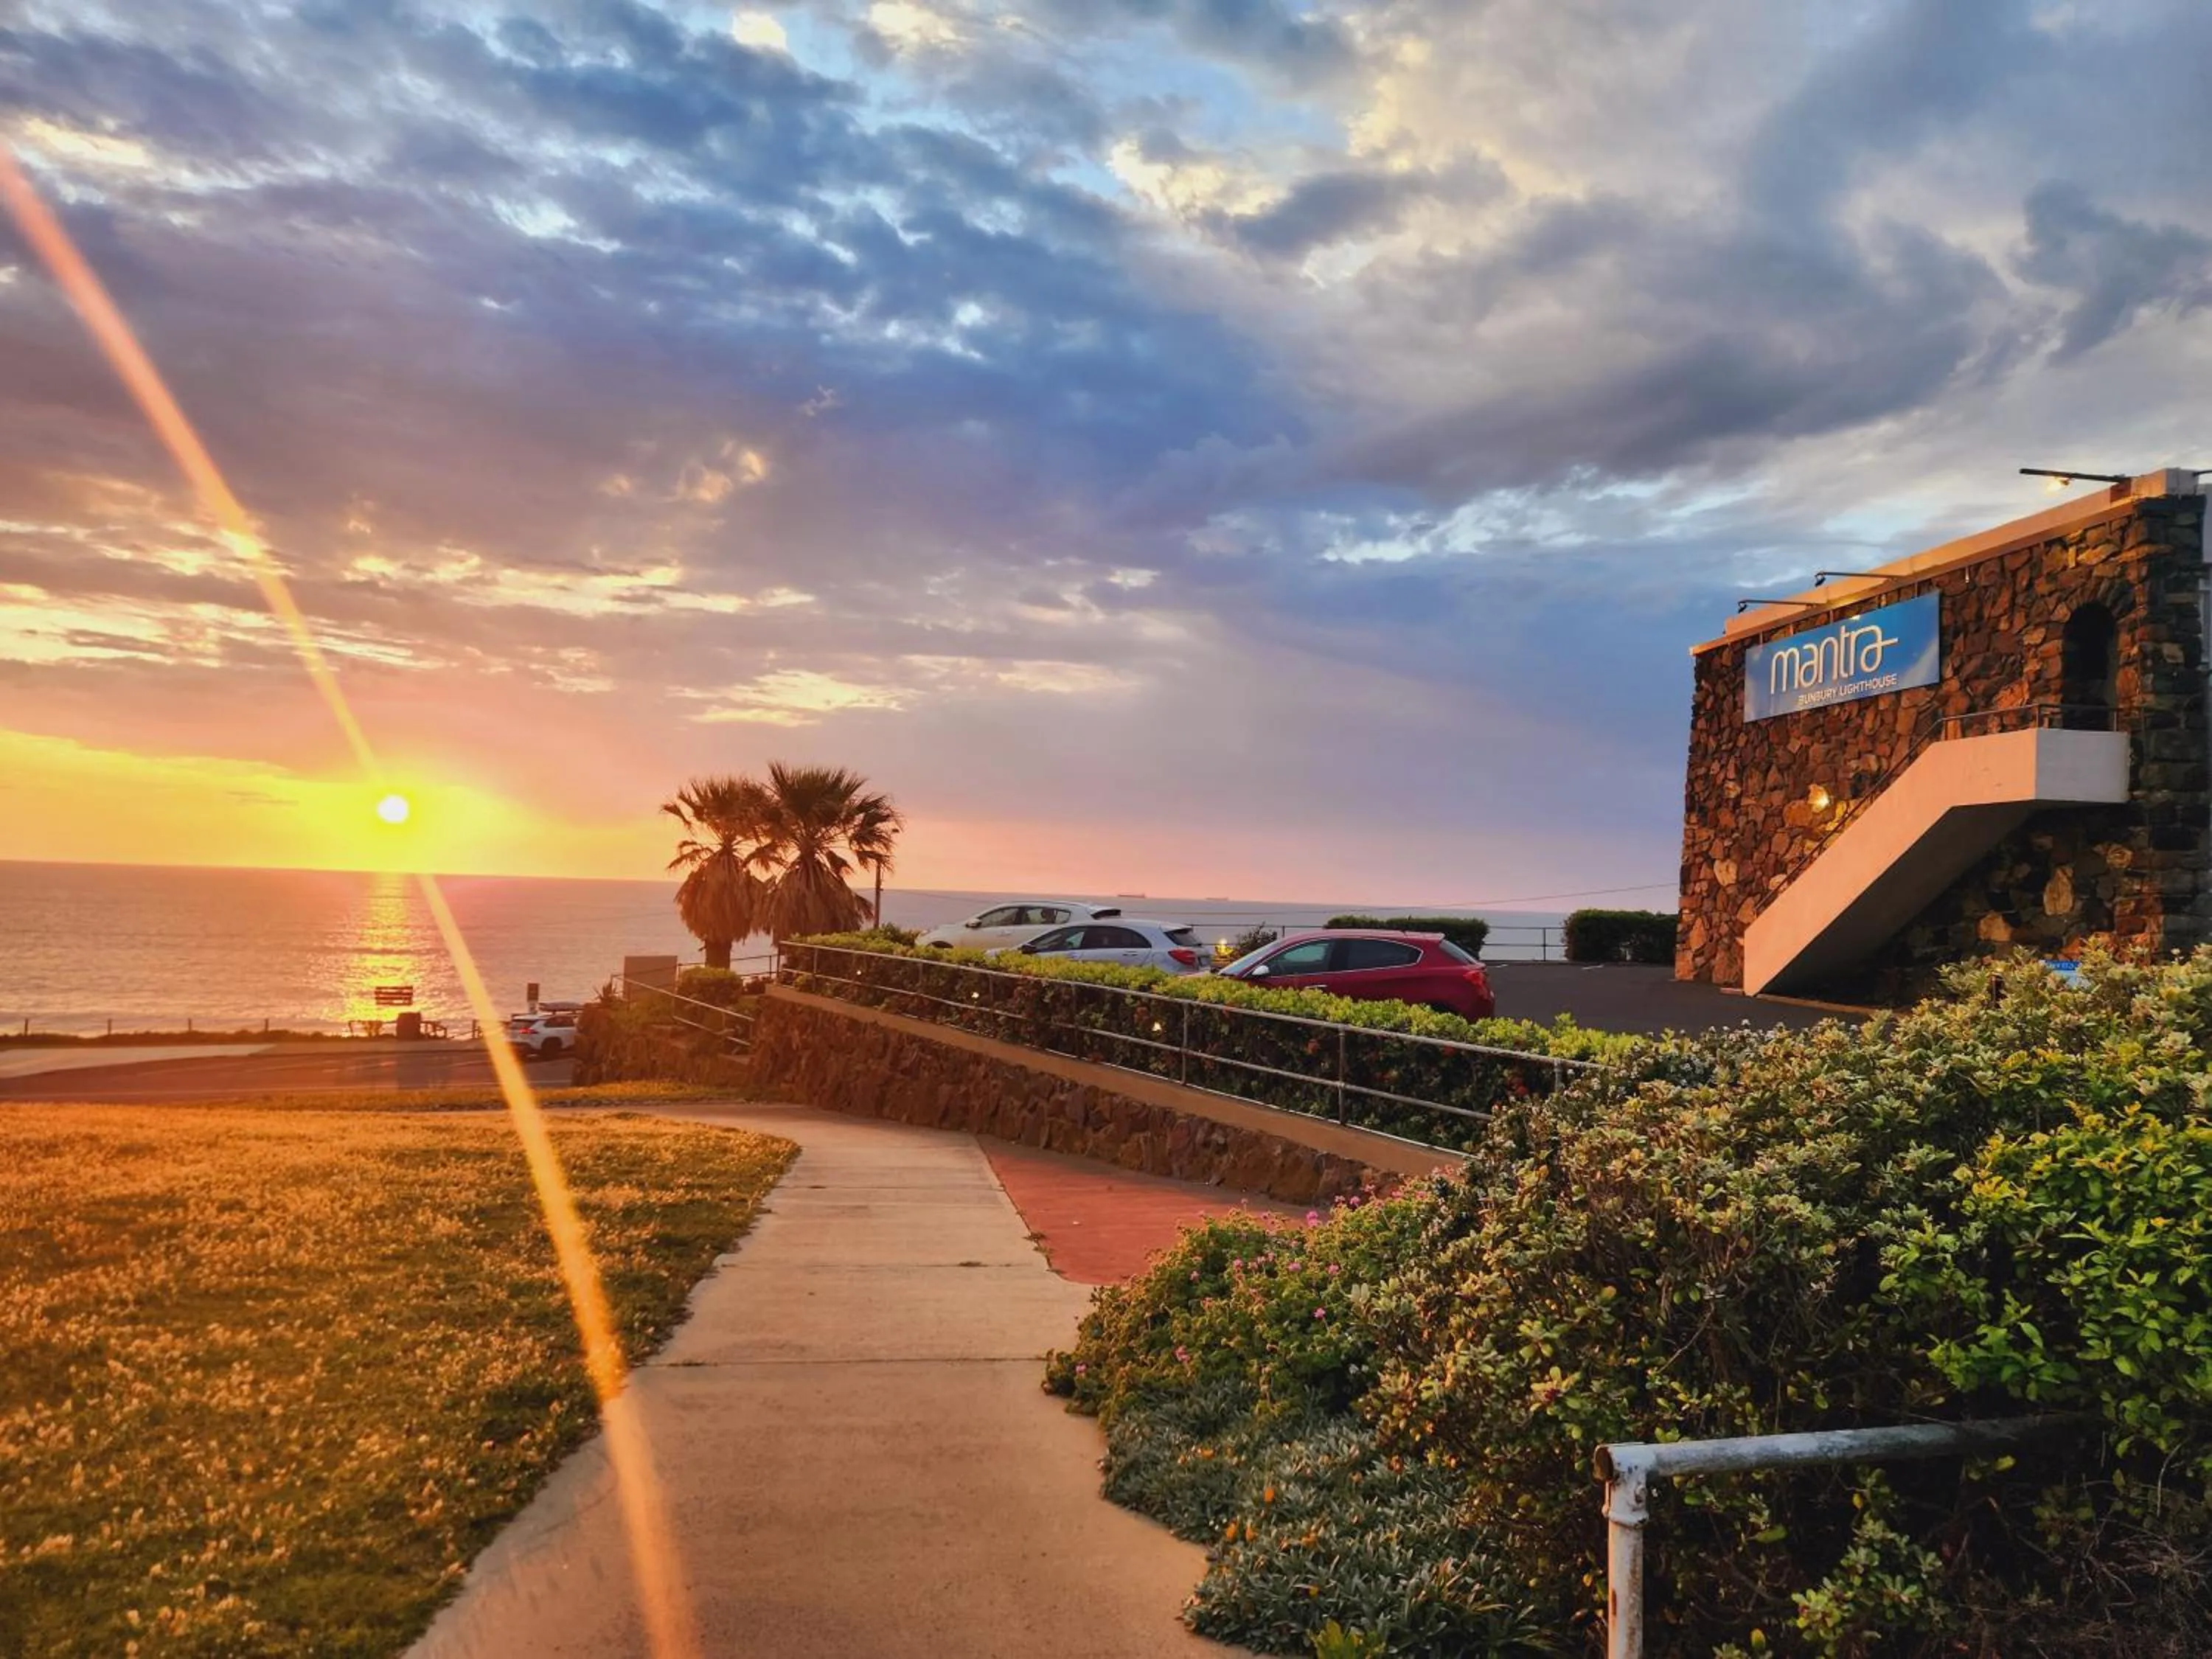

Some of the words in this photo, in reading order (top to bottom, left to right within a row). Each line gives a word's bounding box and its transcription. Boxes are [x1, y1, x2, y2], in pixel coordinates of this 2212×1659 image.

[1770, 625, 1899, 695] mantra
[1798, 686, 1837, 706] BUNBURY
[1840, 673, 1897, 696] LIGHTHOUSE
